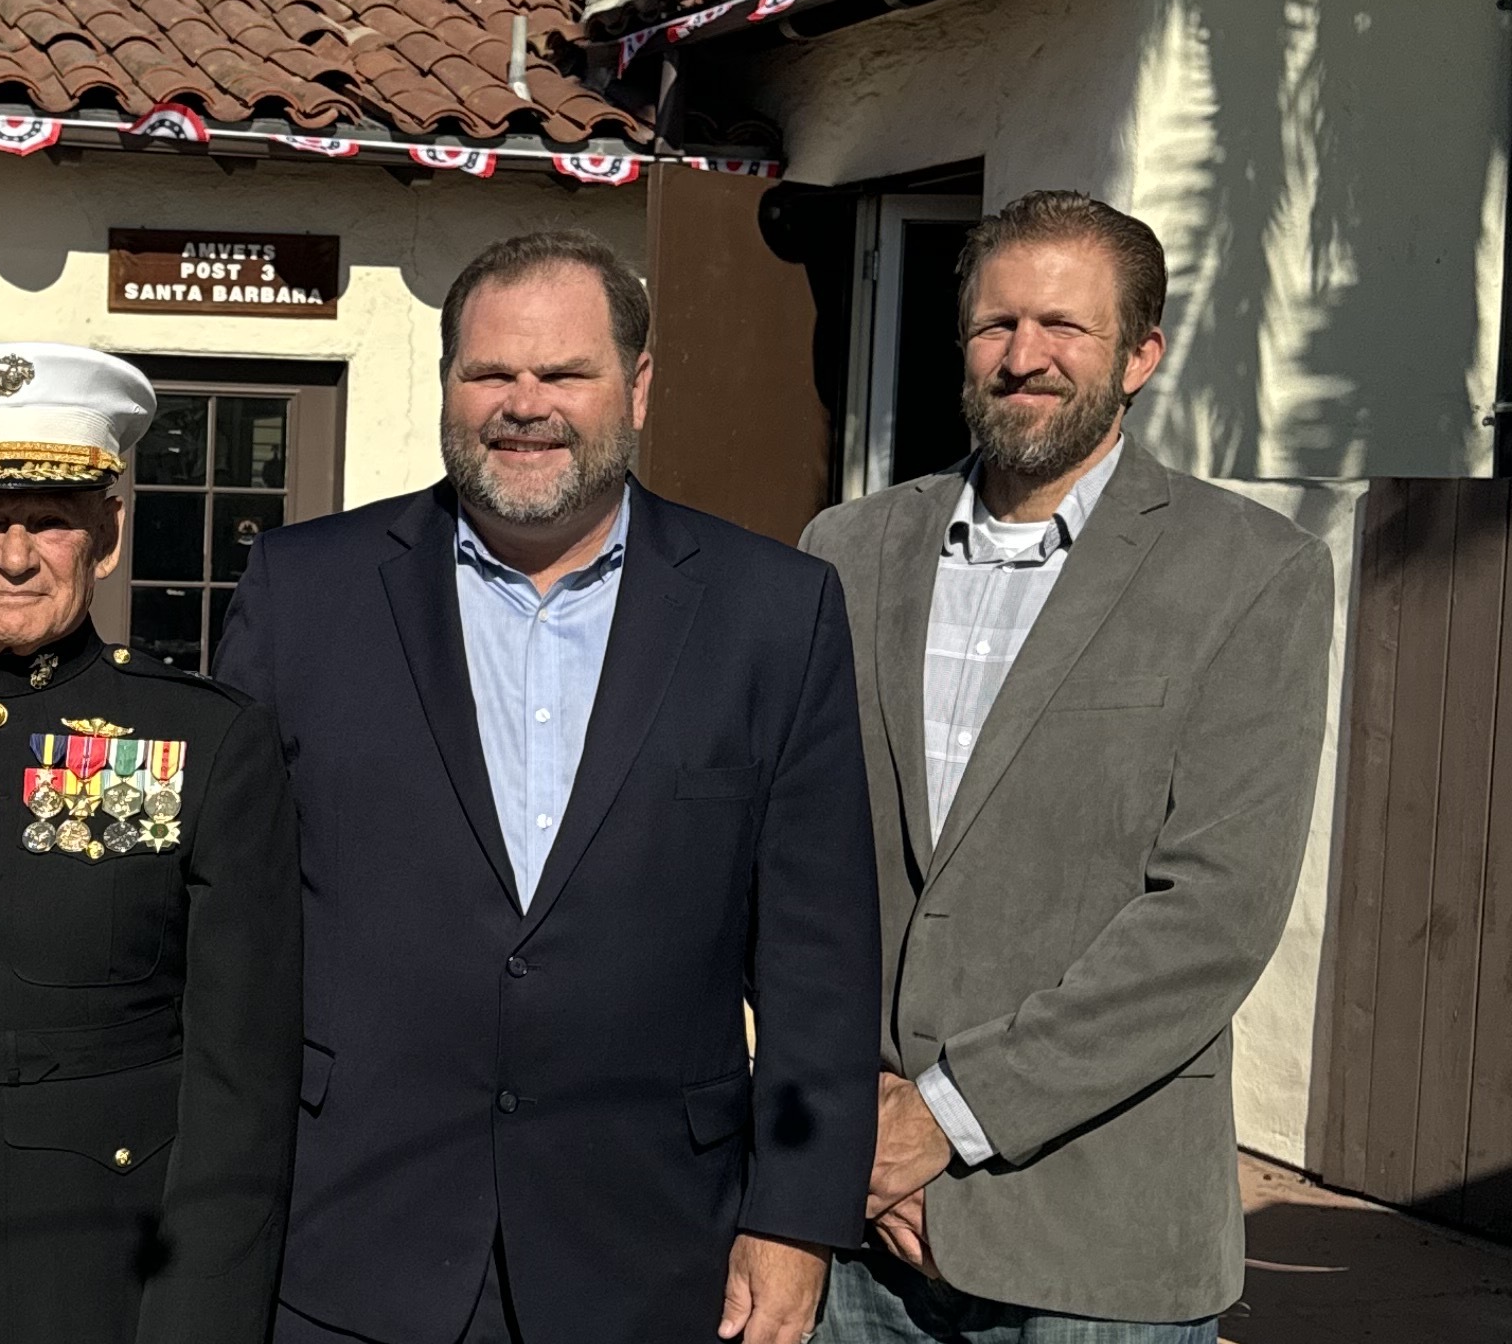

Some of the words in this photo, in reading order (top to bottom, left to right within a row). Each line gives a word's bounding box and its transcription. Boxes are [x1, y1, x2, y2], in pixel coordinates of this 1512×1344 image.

[181, 242, 276, 261] AMVETS
[180, 262, 241, 280] POST
[261, 264, 275, 281] 3
[124, 283, 203, 301] SANTA
[212, 286, 323, 305] BARBARA
